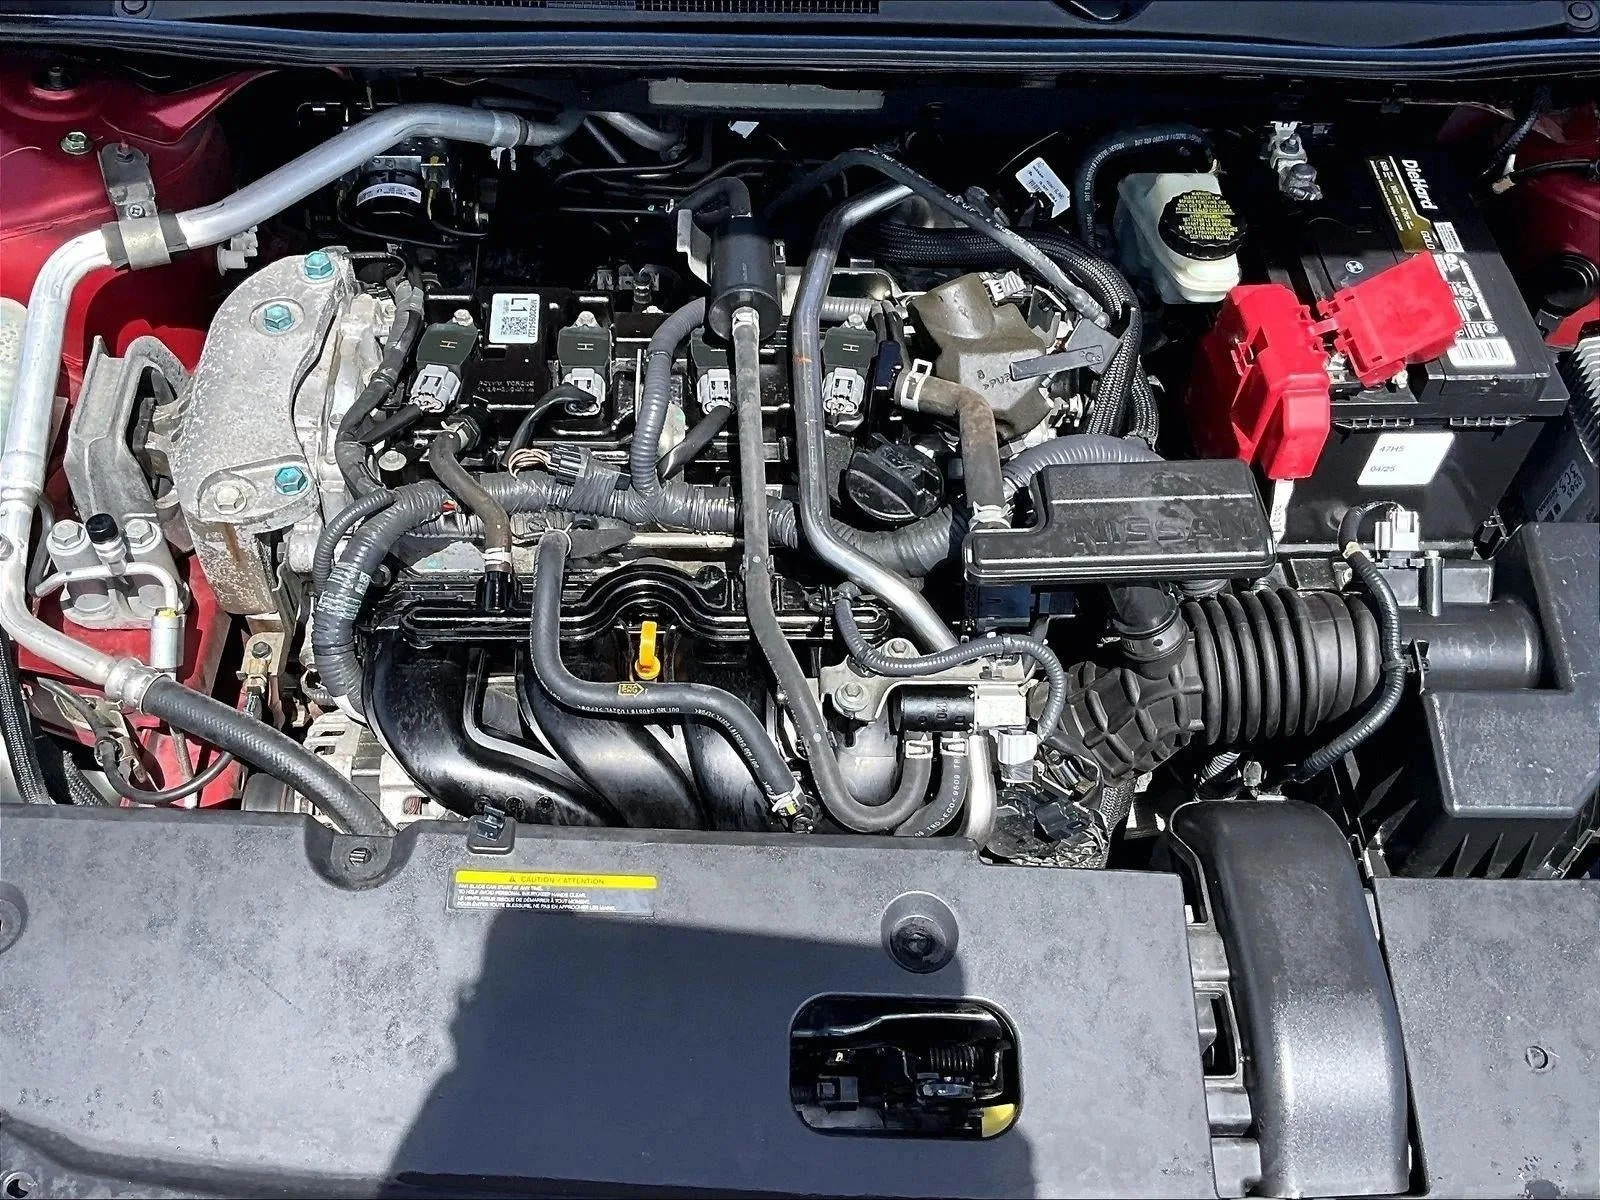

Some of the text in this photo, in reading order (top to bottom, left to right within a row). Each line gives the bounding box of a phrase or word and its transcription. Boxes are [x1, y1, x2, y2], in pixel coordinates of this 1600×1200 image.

[1402, 159, 1437, 210] DieHard
[1421, 230, 1435, 250] GOLD
[510, 298, 529, 312] L1
